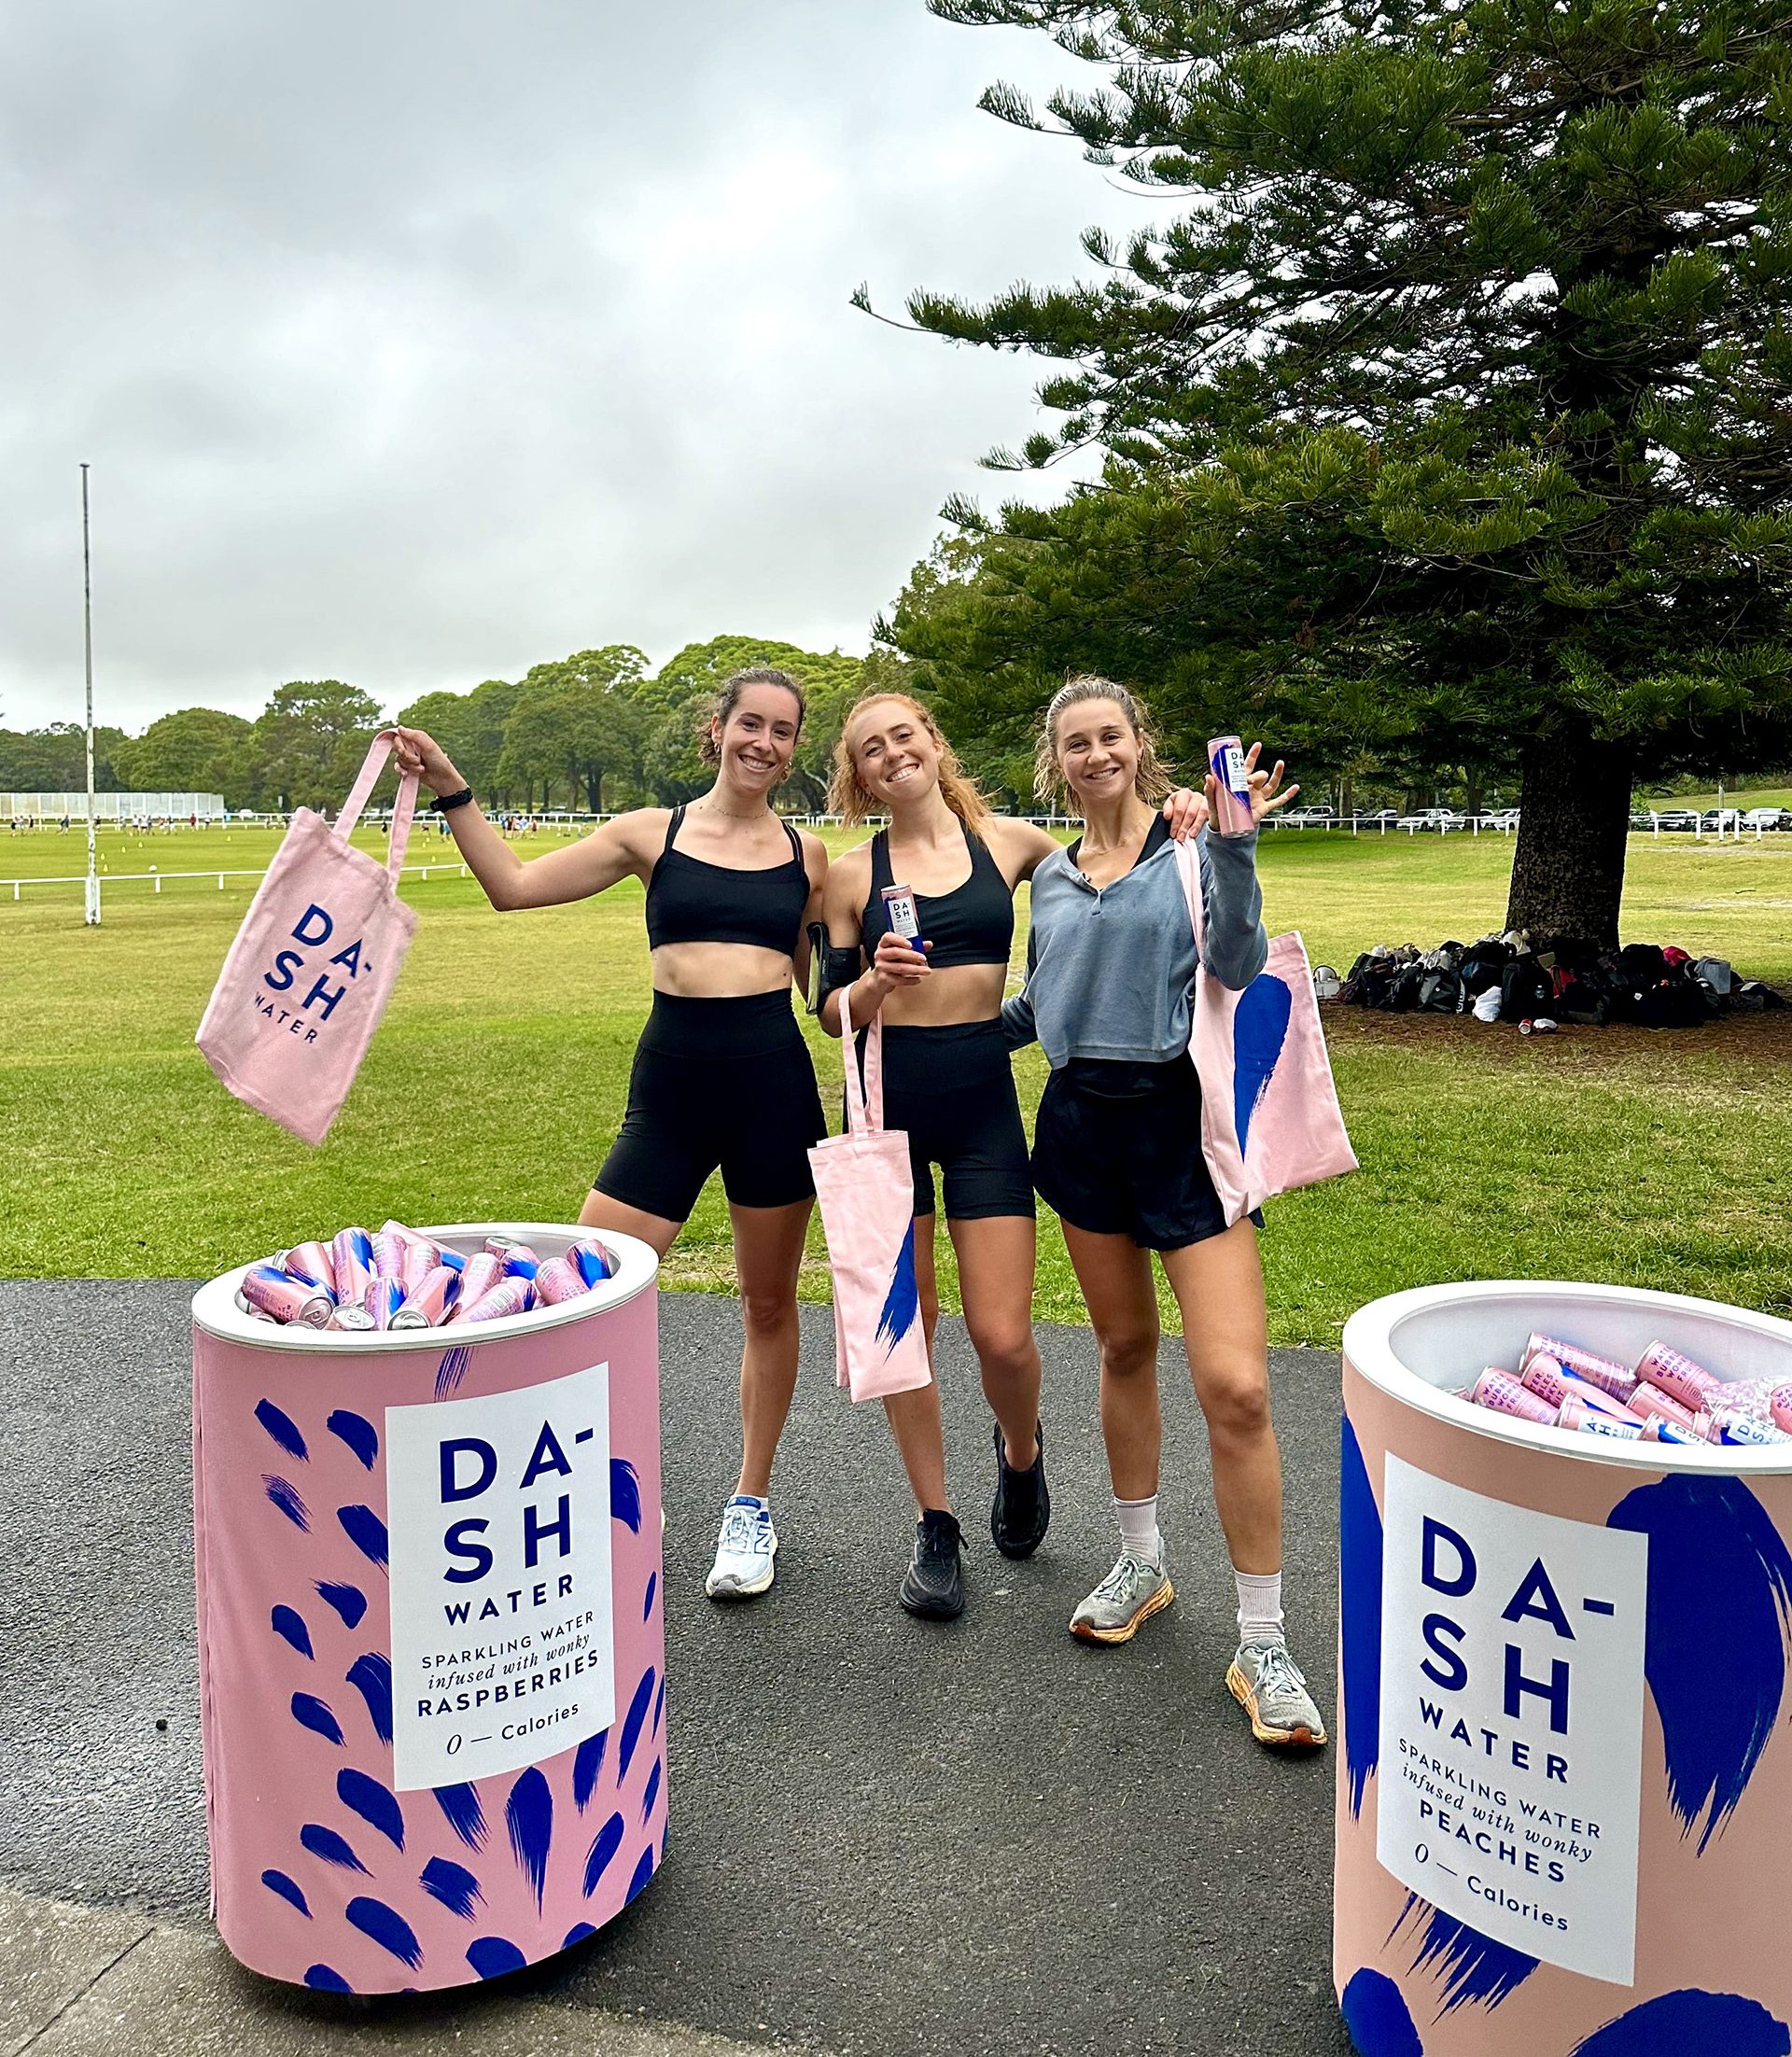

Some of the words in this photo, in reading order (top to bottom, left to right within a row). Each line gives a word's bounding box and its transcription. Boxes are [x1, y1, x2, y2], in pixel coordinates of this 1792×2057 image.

[895, 909, 910, 919] SH
[255, 991, 317, 1043] WATER
[264, 950, 346, 1021] SH
[440, 1420, 594, 1503] DA-
[443, 1494, 571, 1584] SH
[444, 1574, 573, 1626] WATER
[1421, 1515, 1615, 1641] DA-
[422, 1635, 532, 1669] SPARKLING
[540, 1611, 595, 1641] WATER
[427, 1665, 496, 1690] infused
[503, 1654, 539, 1675] with
[546, 1631, 591, 1662] wonky
[1420, 1613, 1570, 1735] SH
[417, 1649, 598, 1717] RASPBERRIES
[501, 1703, 580, 1742] Calories
[1419, 1697, 1569, 1784] WATER
[1399, 1739, 1507, 1807] SPARKLING
[1519, 1798, 1602, 1840] WATER
[1403, 1763, 1464, 1812] infused
[1472, 1806, 1516, 1835] with
[1525, 1828, 1593, 1863] wonky
[1420, 1799, 1565, 1883] PEACHES
[1467, 1875, 1569, 1932] Calories
